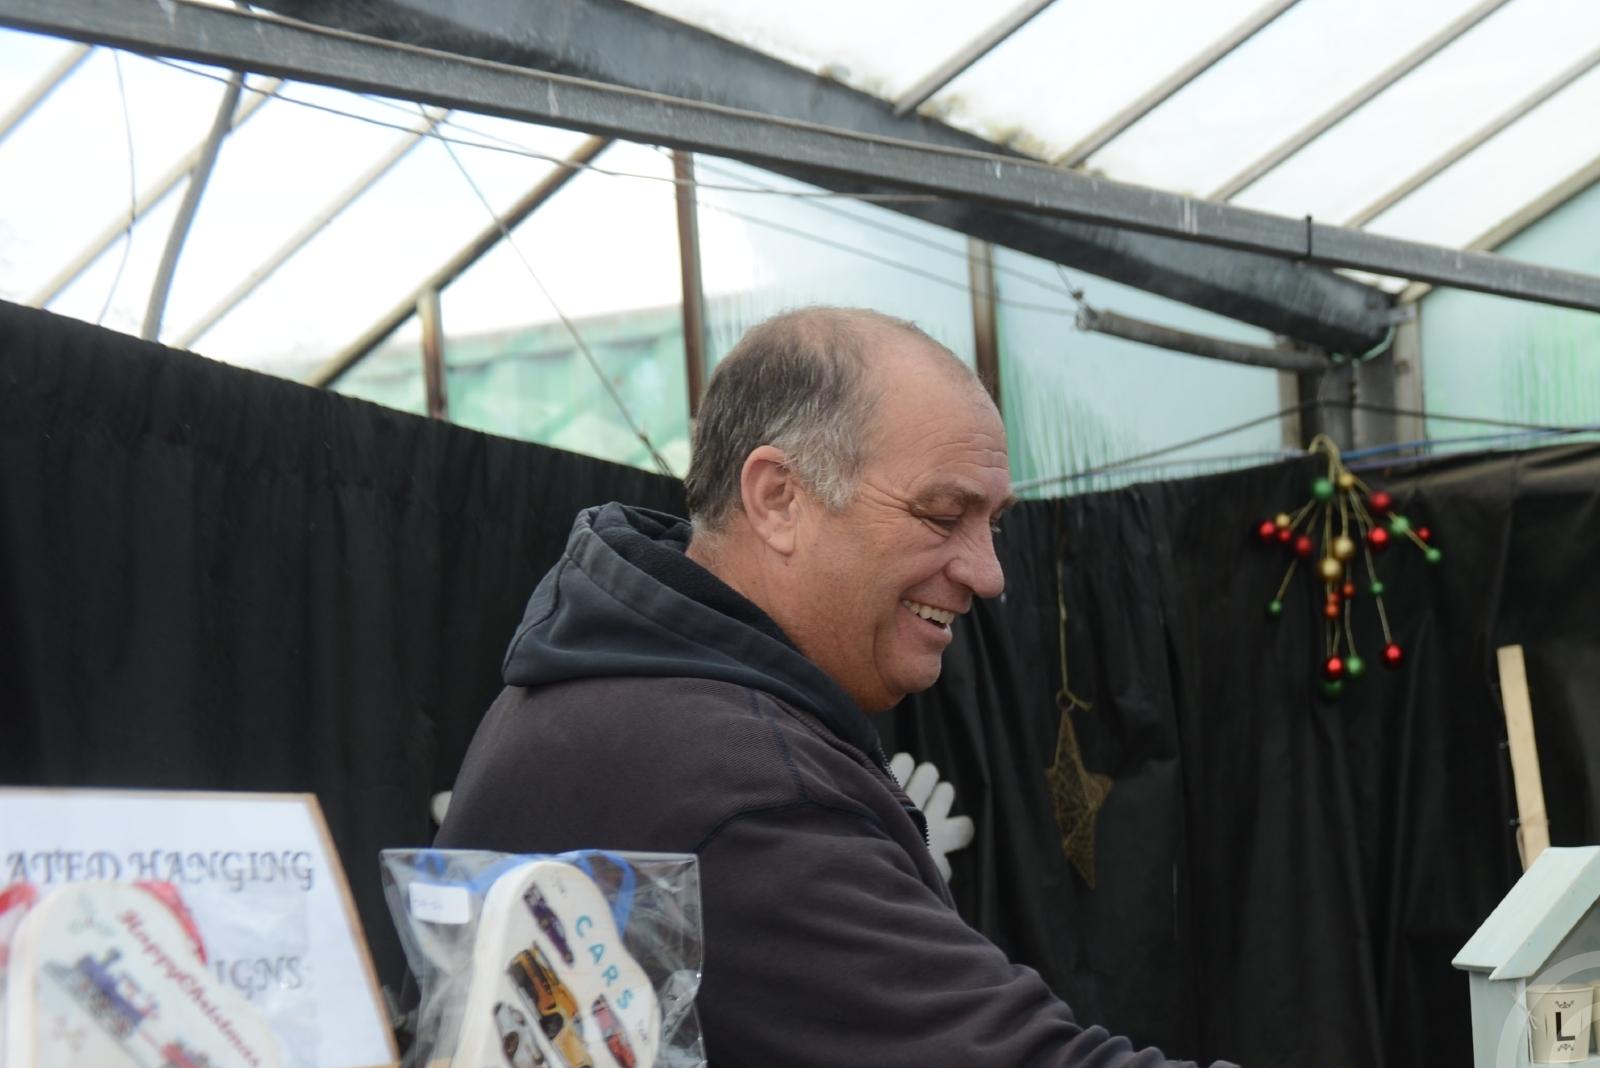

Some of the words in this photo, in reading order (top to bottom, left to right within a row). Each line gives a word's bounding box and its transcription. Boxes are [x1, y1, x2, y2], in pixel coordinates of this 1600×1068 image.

[128, 849, 316, 892] HANGING
[216, 954, 303, 1000] IGNS
[575, 914, 635, 1010] CARS
[1555, 1011, 1576, 1042] L
